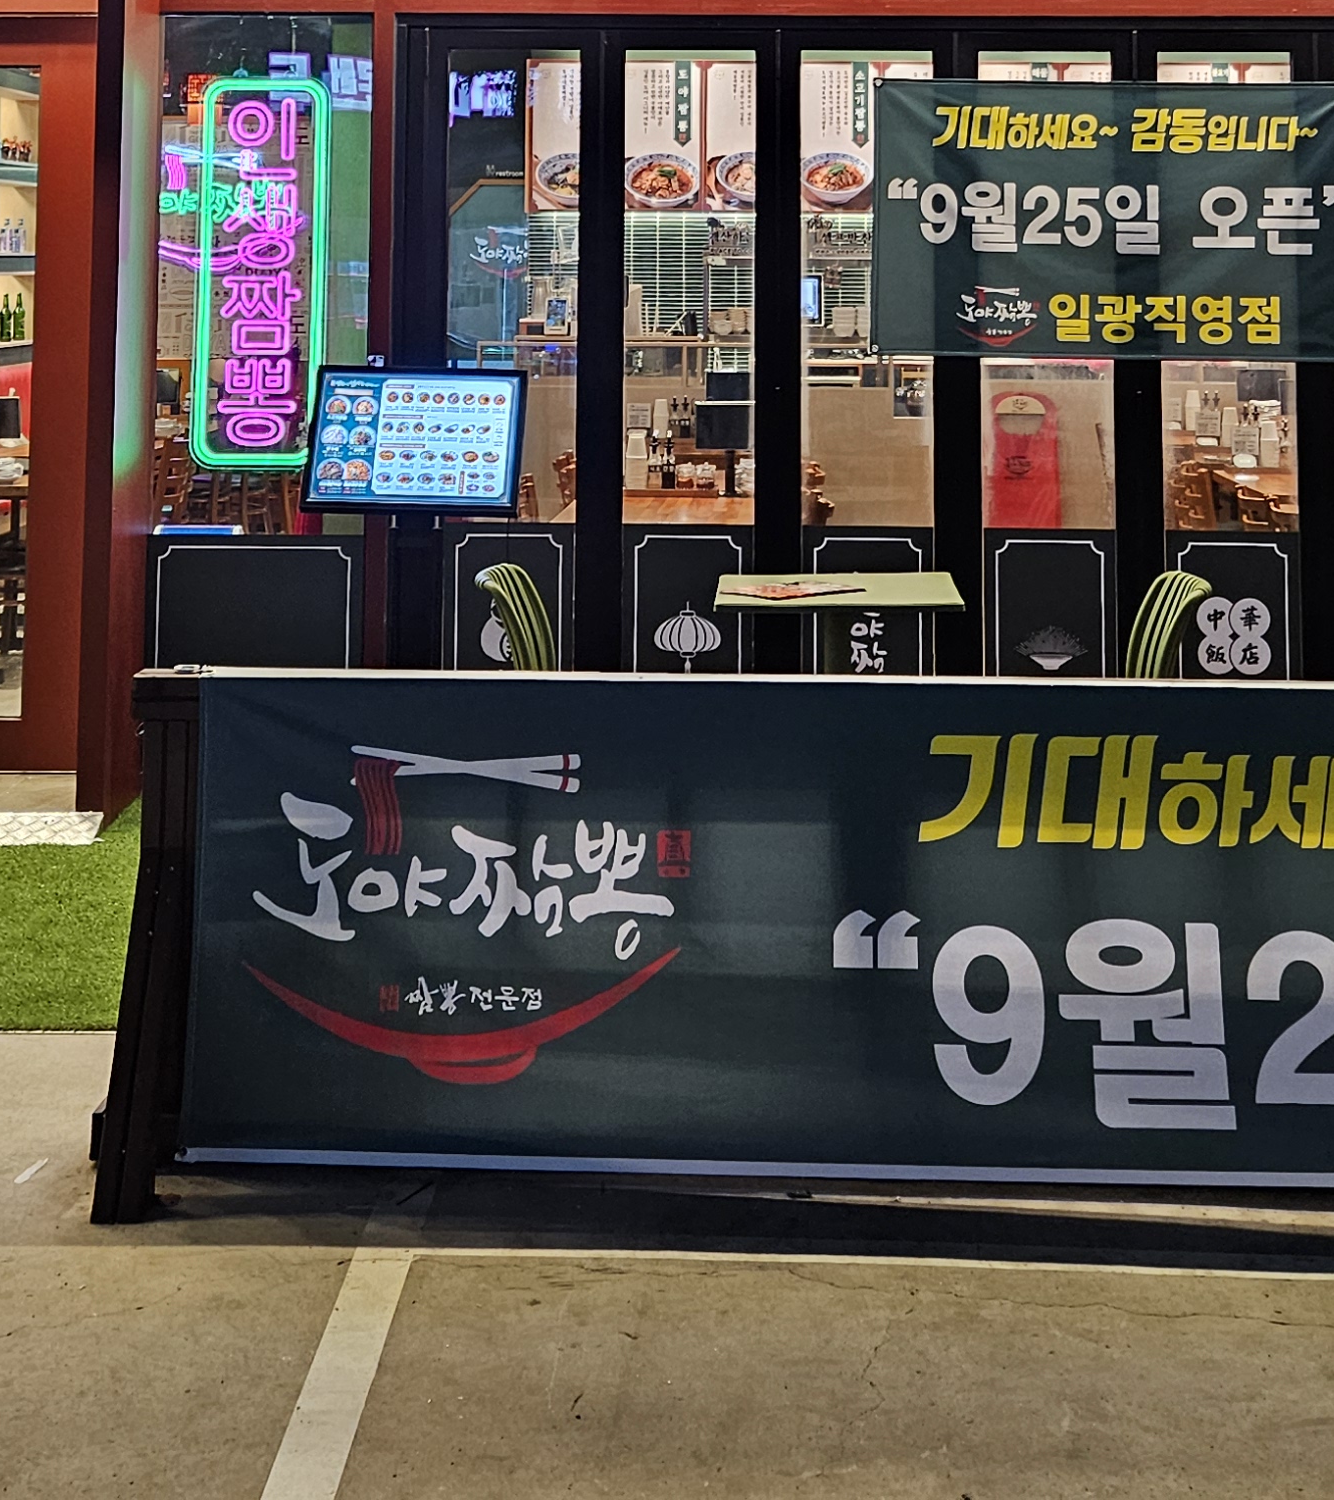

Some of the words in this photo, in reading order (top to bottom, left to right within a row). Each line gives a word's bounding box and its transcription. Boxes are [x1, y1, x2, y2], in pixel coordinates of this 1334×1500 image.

[853, 69, 867, 133] 소고기짬뽕
[931, 105, 1119, 151] 기대하세요~
[1130, 107, 1319, 155] 감동입니다~
[886, 176, 1162, 256] “9월25일
[217, 97, 302, 449] 인생짬뽕
[955, 294, 1039, 327] 도야짬뽕
[1048, 293, 1282, 346] 일광직영점
[251, 790, 676, 962] 도야짬뽕
[405, 976, 467, 1017] 짬뽕
[469, 985, 543, 1013] 전문점
